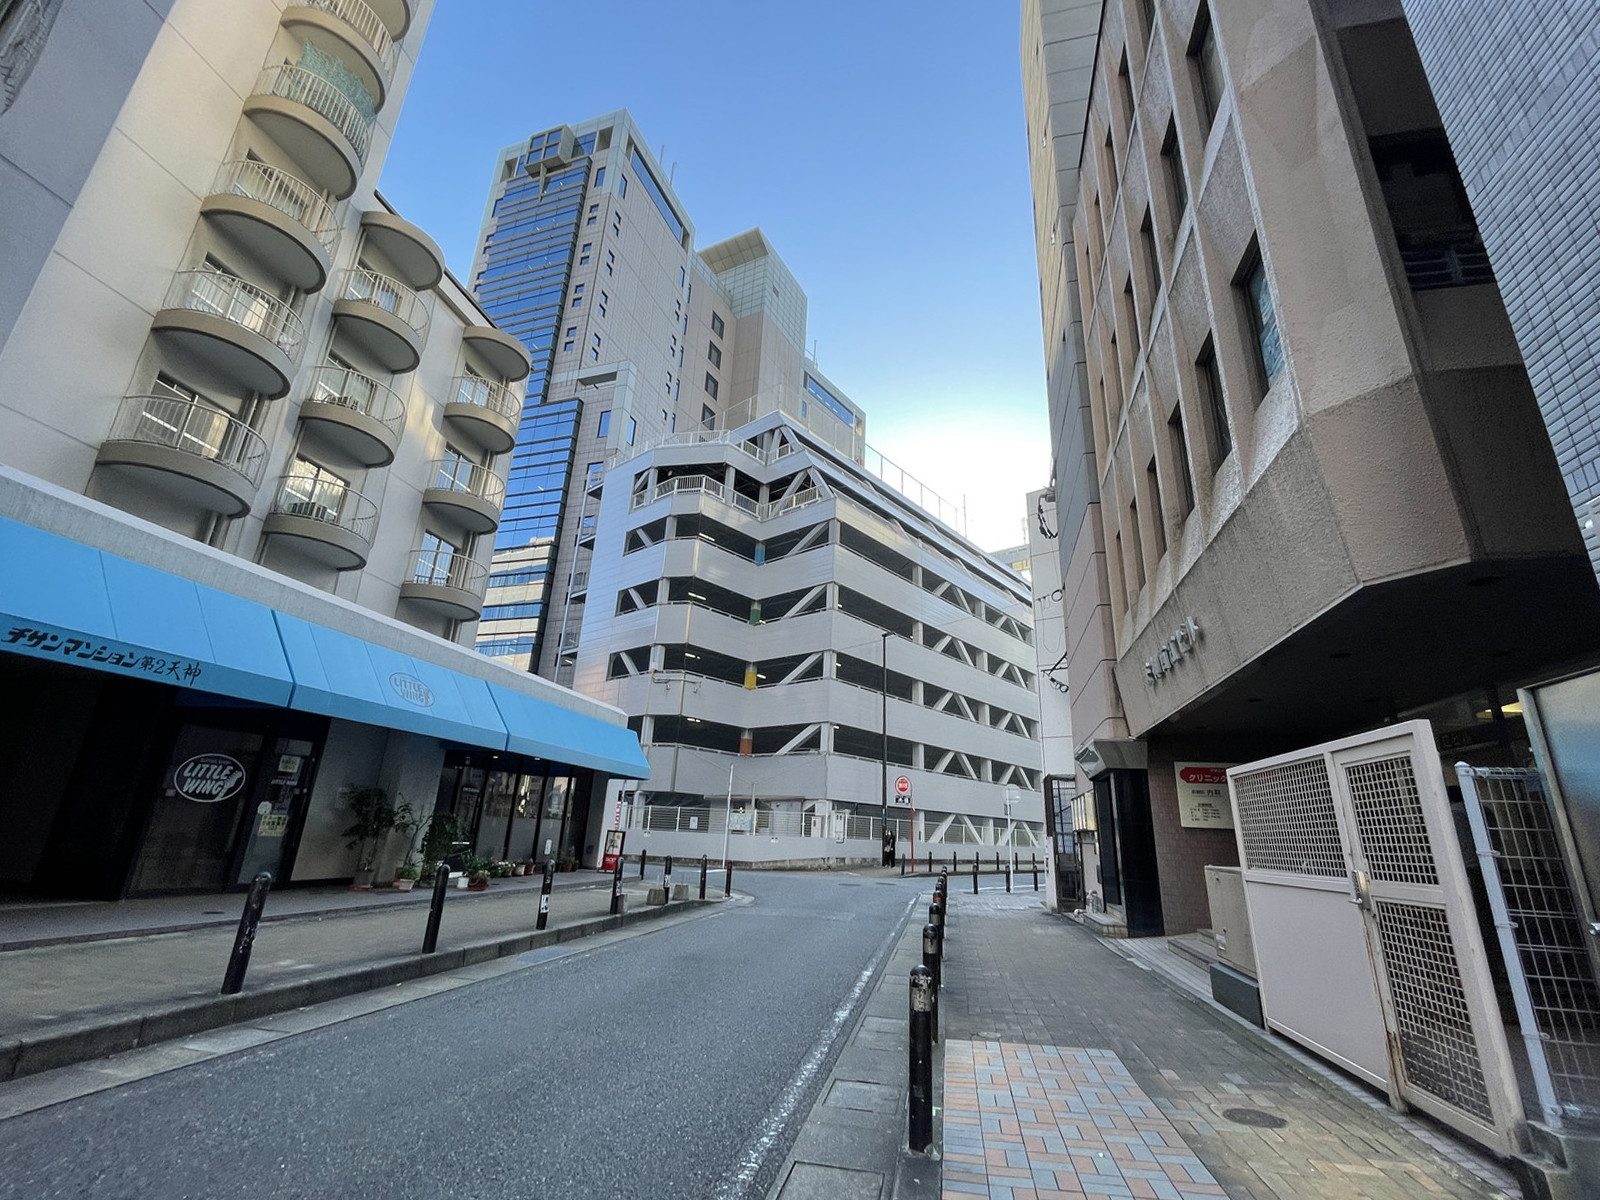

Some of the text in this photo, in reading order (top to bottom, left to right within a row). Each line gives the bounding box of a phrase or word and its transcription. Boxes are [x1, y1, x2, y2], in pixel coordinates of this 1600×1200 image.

[1, 627, 202, 686] チサンマンション第2天神
[393, 677, 423, 692] LITTLE
[400, 689, 425, 703] WING
[183, 762, 233, 780] LITTLE
[1189, 774, 1227, 783] クリニック
[182, 778, 224, 795] WING
